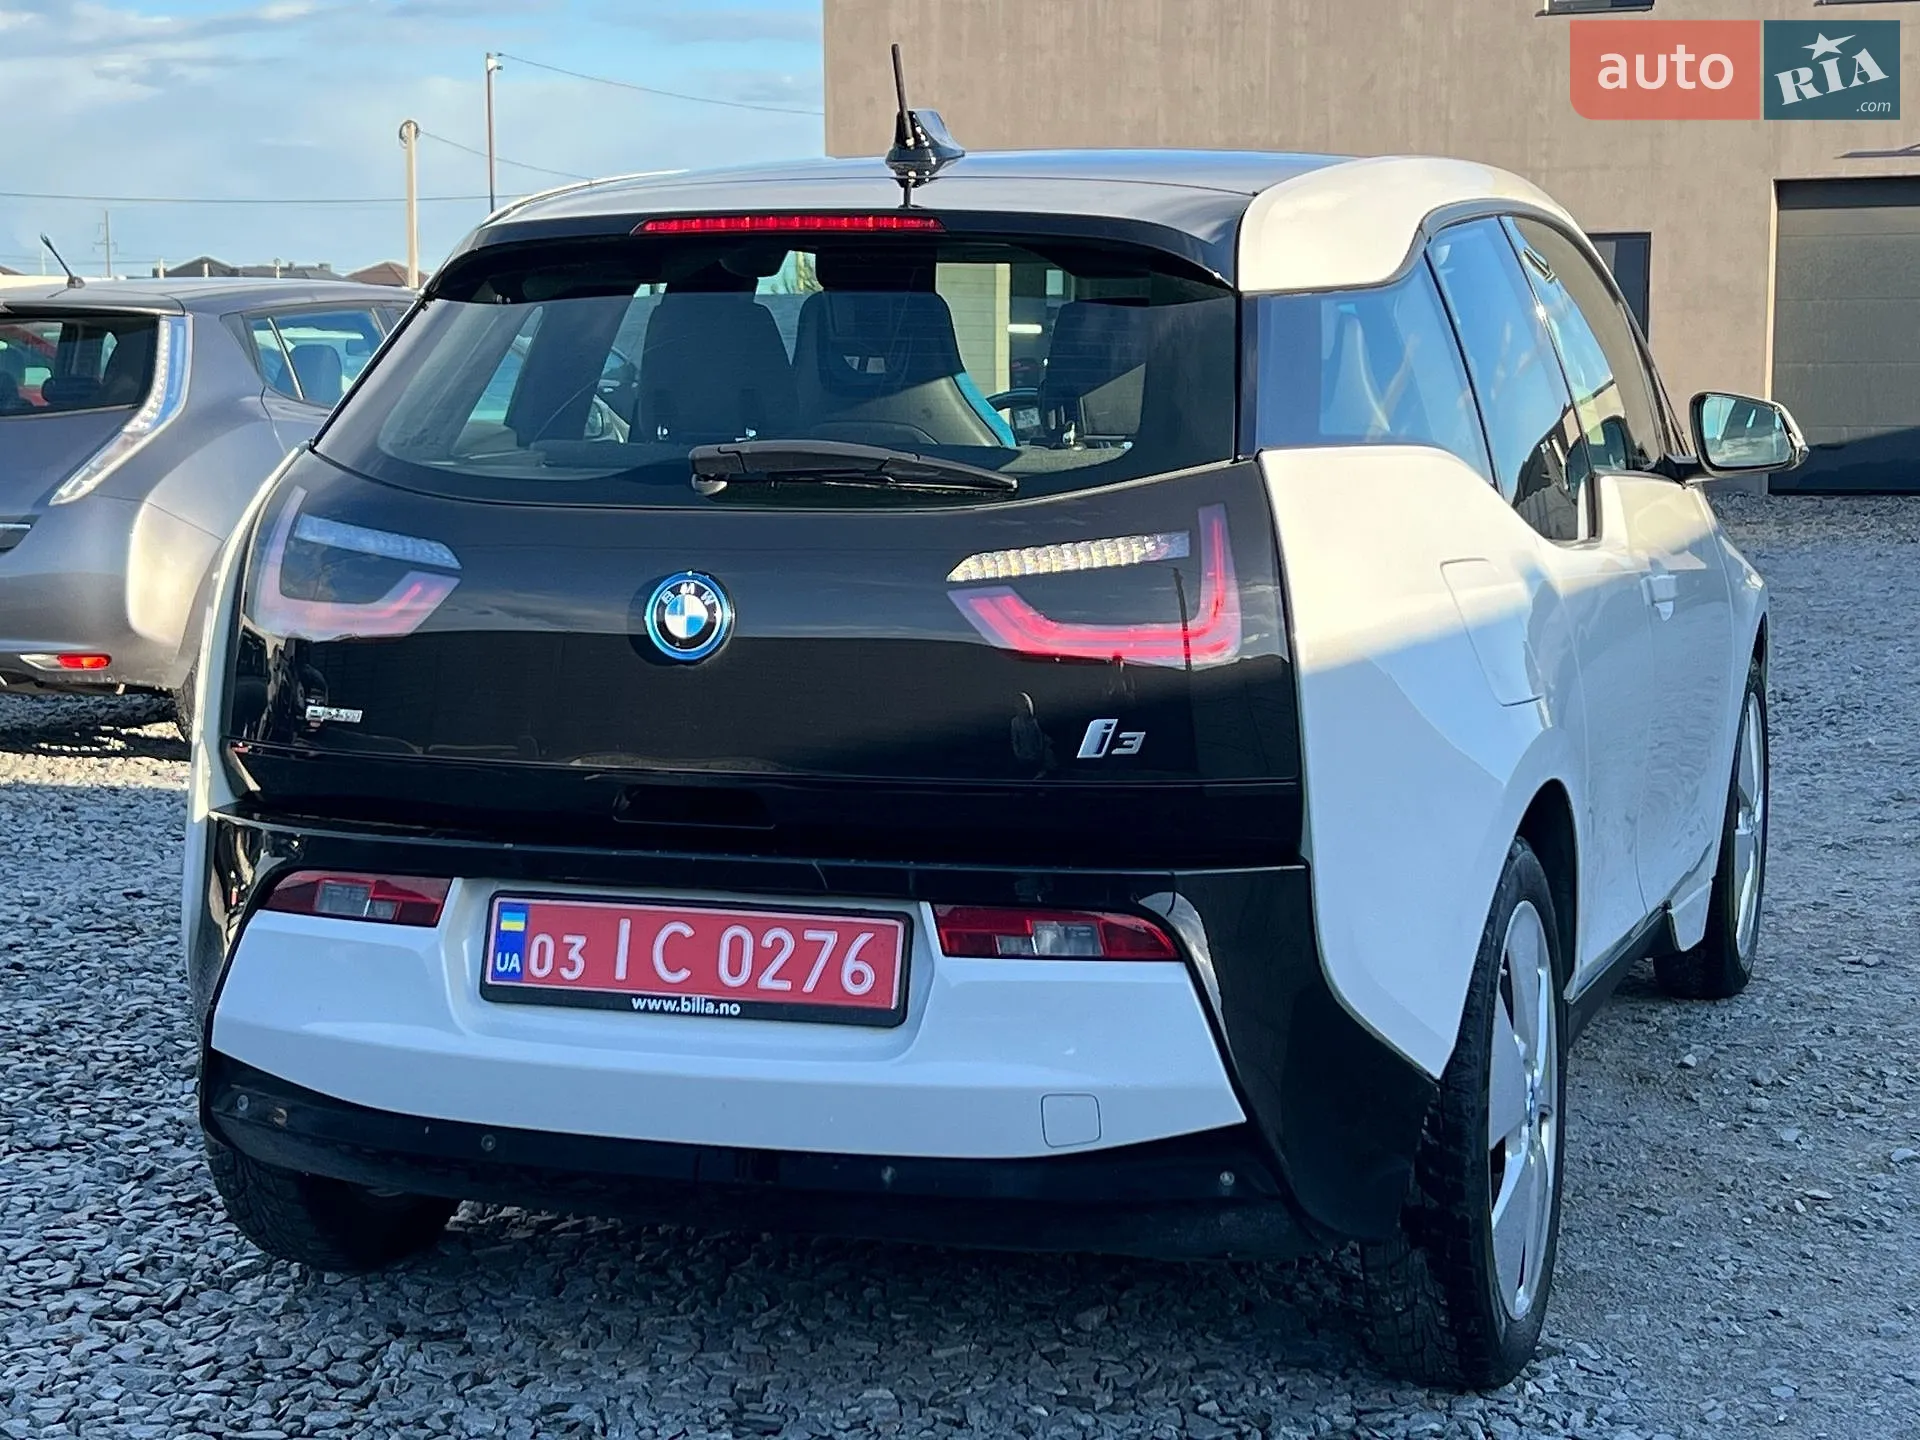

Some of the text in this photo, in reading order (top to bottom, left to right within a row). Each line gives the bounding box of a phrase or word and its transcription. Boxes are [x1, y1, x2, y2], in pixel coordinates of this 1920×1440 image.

[661, 582, 716, 606] BMW
[1077, 719, 1146, 758] i3
[497, 951, 521, 973] UA
[529, 933, 587, 980] 03
[718, 924, 876, 996] 0276
[631, 996, 741, 1016] www.bilia.no
